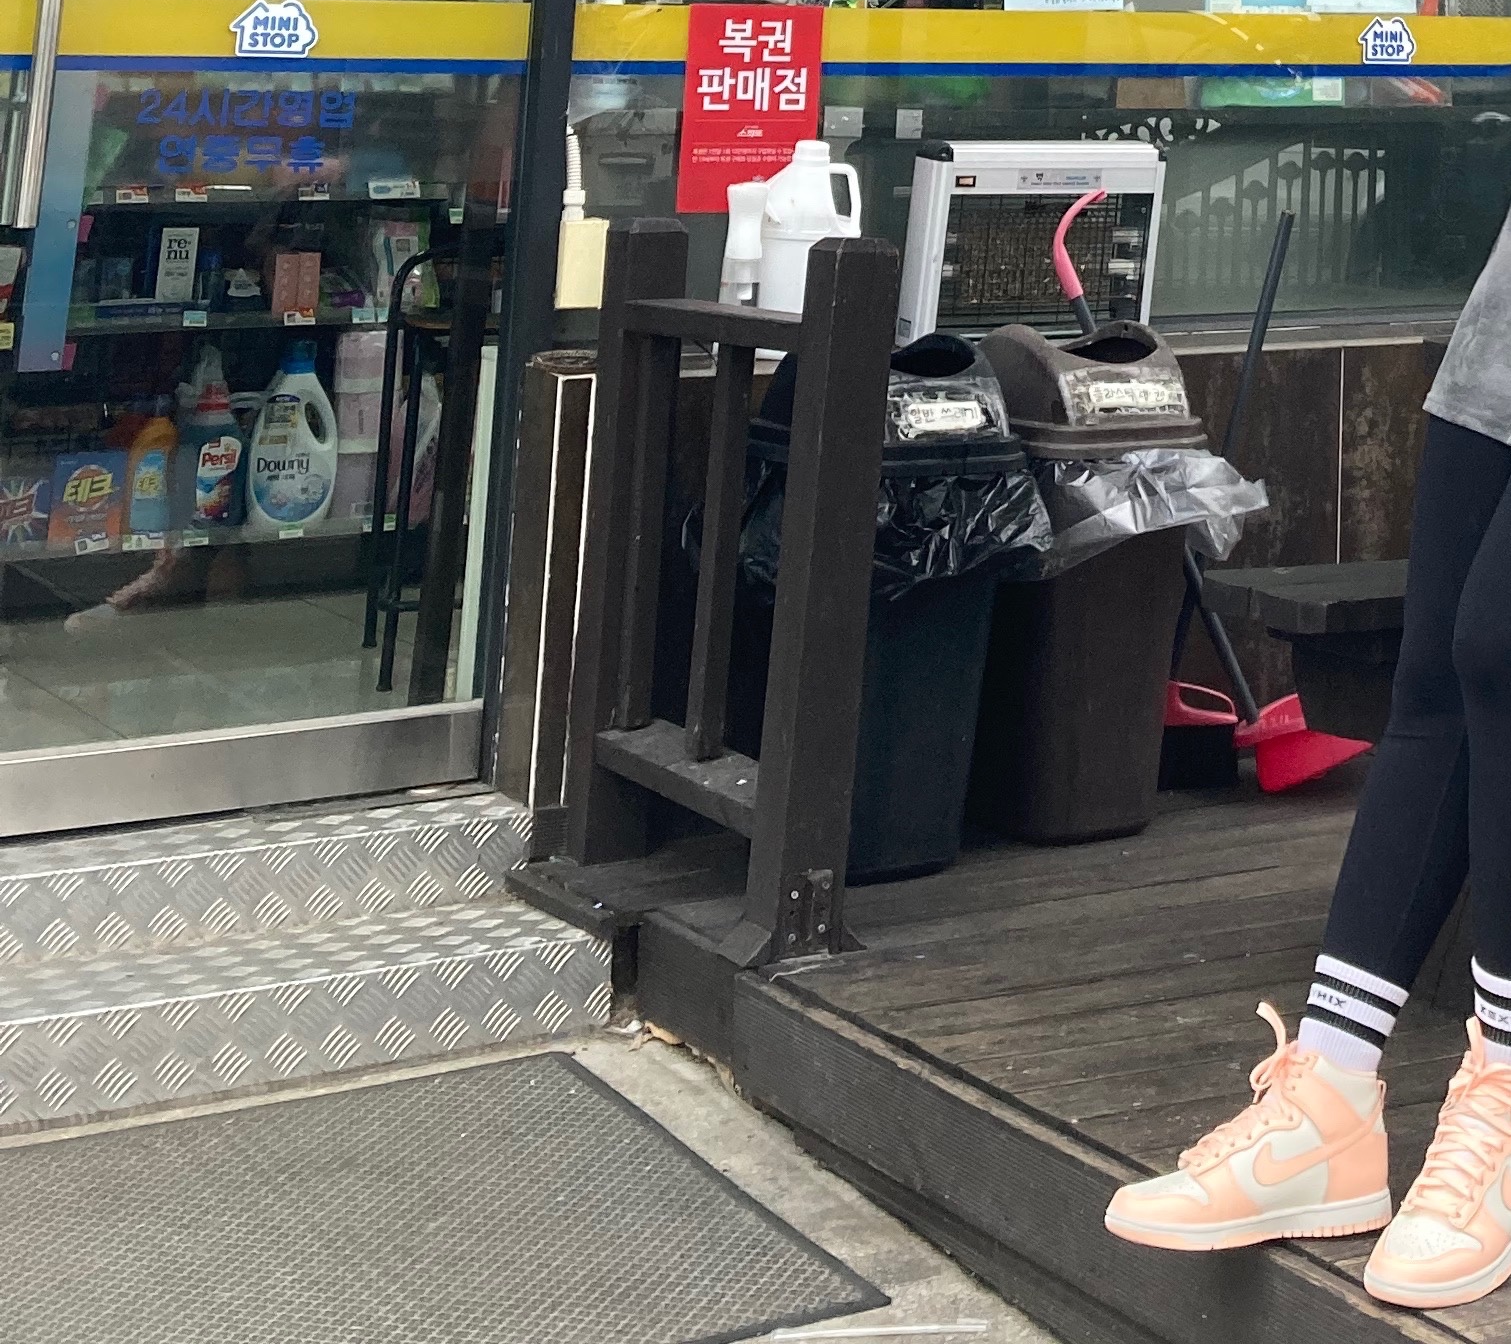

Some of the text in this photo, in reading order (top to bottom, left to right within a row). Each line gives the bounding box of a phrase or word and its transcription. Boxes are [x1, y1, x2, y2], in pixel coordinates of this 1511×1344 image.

[252, 15, 299, 31] MINI
[247, 31, 300, 49] STOP
[718, 18, 793, 63] 복권
[1373, 30, 1403, 43] MINI
[1371, 43, 1405, 57] STOP
[696, 67, 808, 112] 판매점
[135, 87, 357, 129] 24시간영업
[157, 133, 326, 175] 연중무휴
[165, 249, 190, 261] nu
[256, 456, 310, 475] Downy
